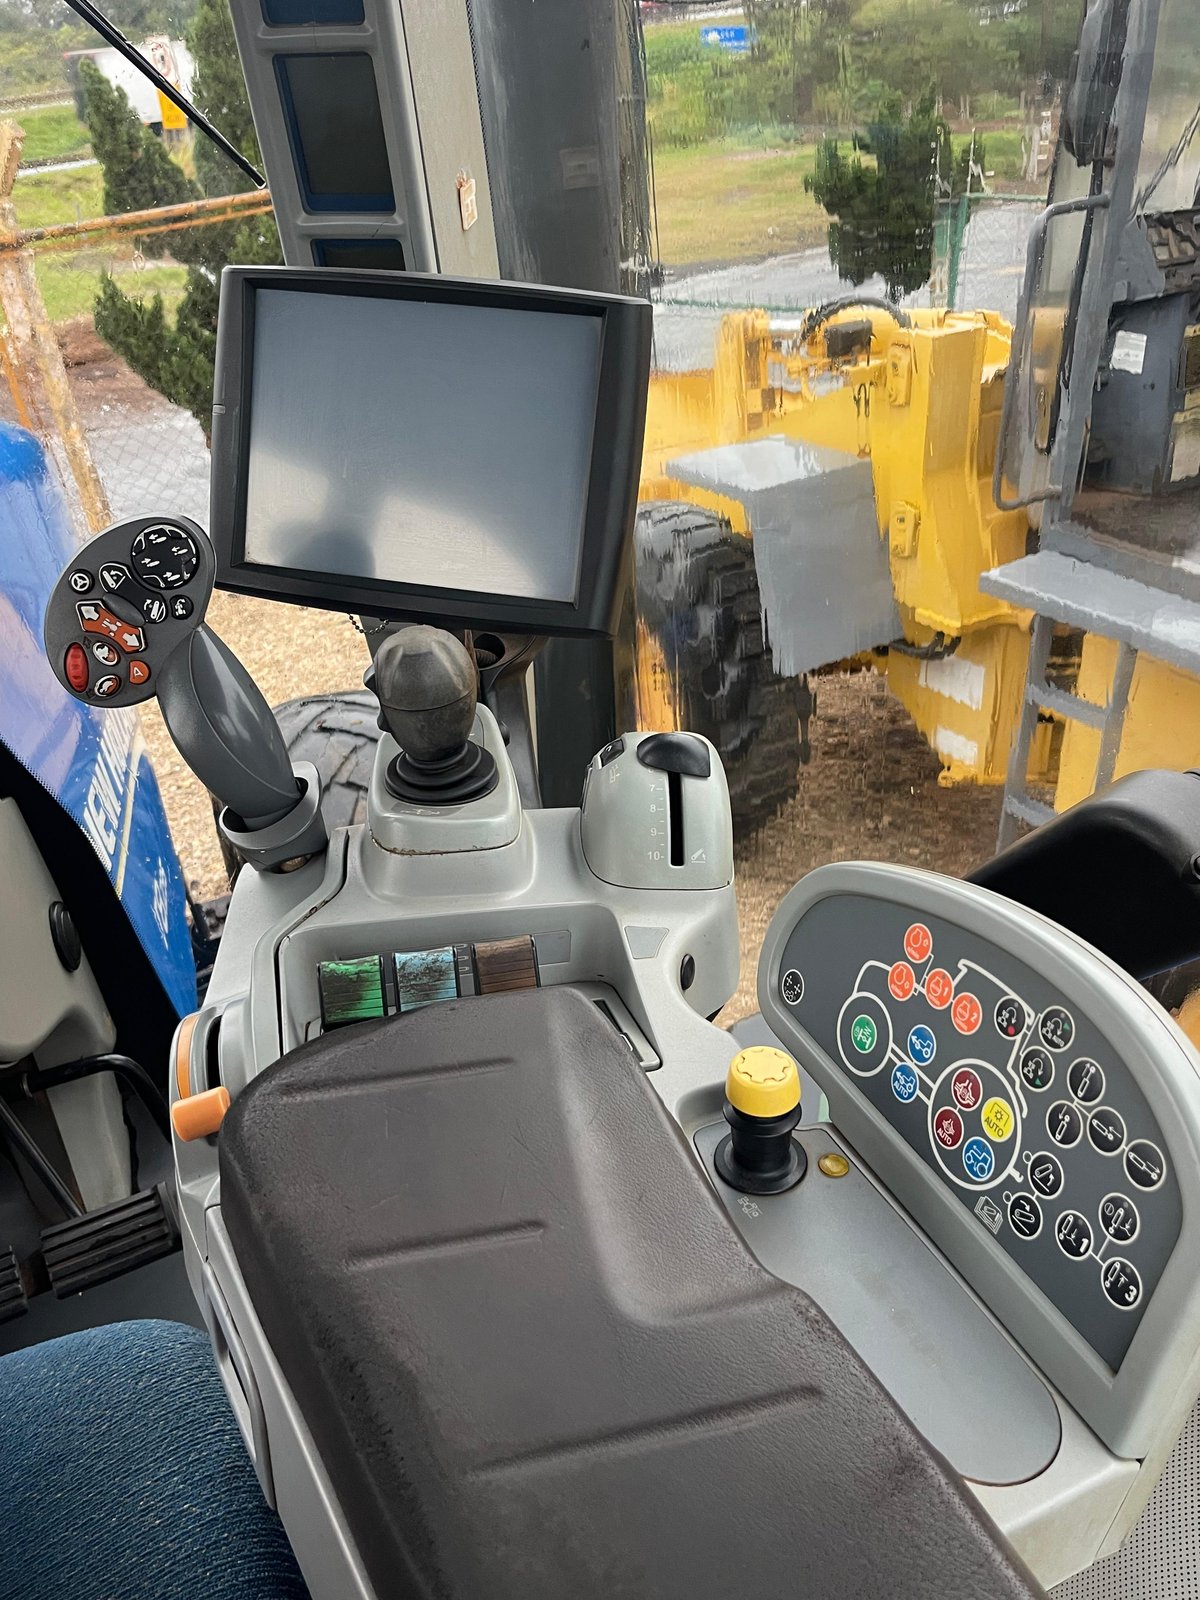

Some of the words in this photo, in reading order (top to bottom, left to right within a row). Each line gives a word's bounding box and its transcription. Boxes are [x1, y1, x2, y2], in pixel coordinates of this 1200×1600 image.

[649, 784, 656, 792] 7
[650, 804, 656, 813] 8
[650, 827, 657, 836] 9
[647, 851, 660, 860] 10
[943, 987, 949, 997] 1
[970, 1012, 978, 1023] 2
[893, 1080, 908, 1098] AUTO
[984, 1116, 1004, 1138] AUTO
[936, 1127, 952, 1145] AUTO
[1079, 1238, 1089, 1253] 1
[1124, 1285, 1137, 1302] 3
